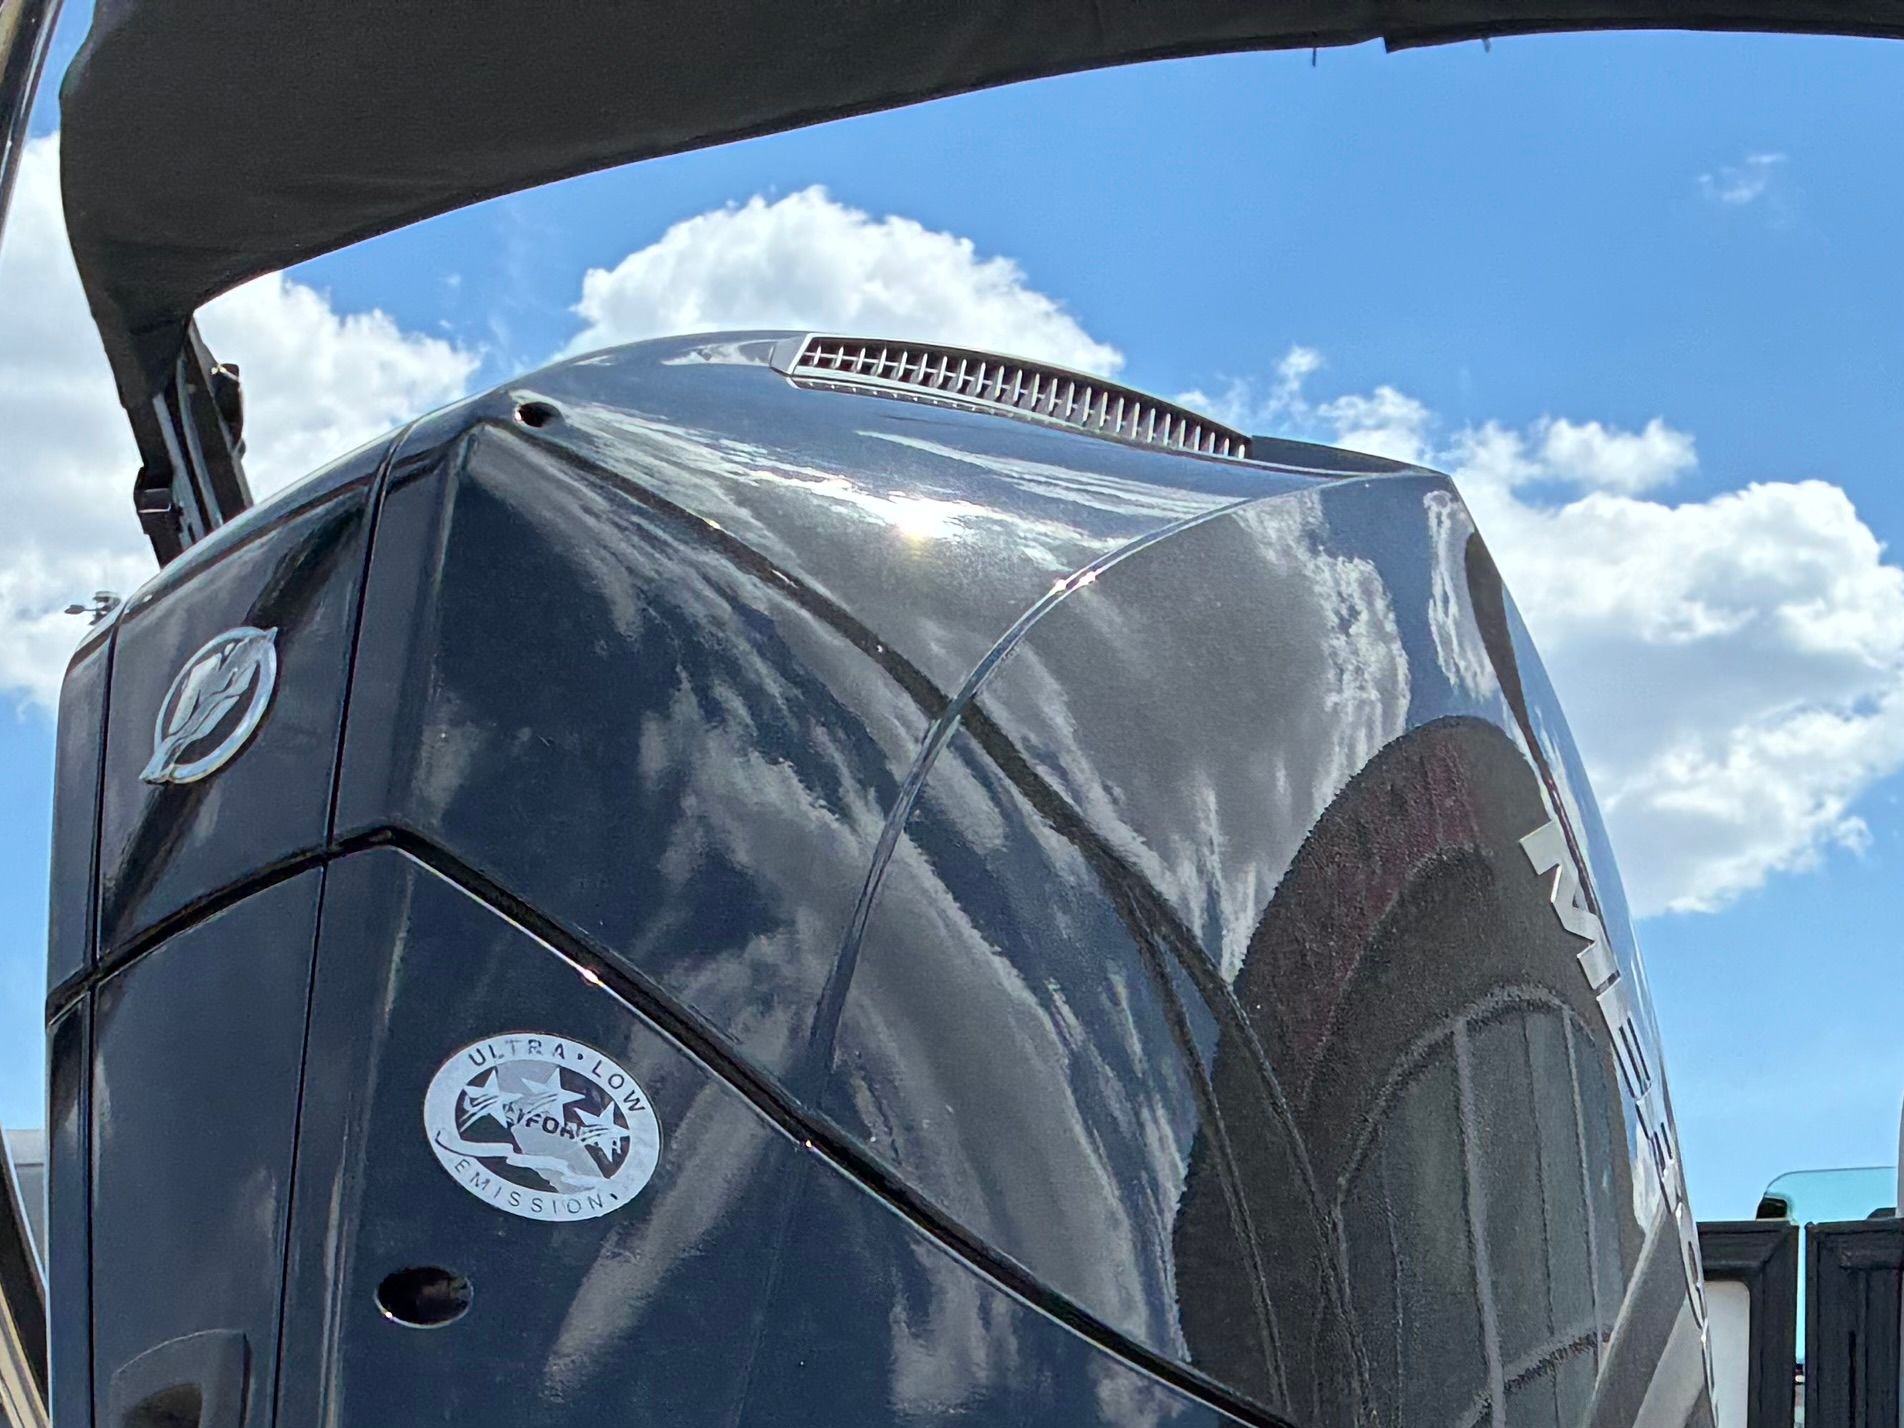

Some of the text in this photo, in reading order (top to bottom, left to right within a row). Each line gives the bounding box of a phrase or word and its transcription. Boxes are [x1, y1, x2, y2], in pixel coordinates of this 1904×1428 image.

[467, 1038, 647, 1114] ULTRA LOW
[452, 1157, 605, 1214] EMISSION
